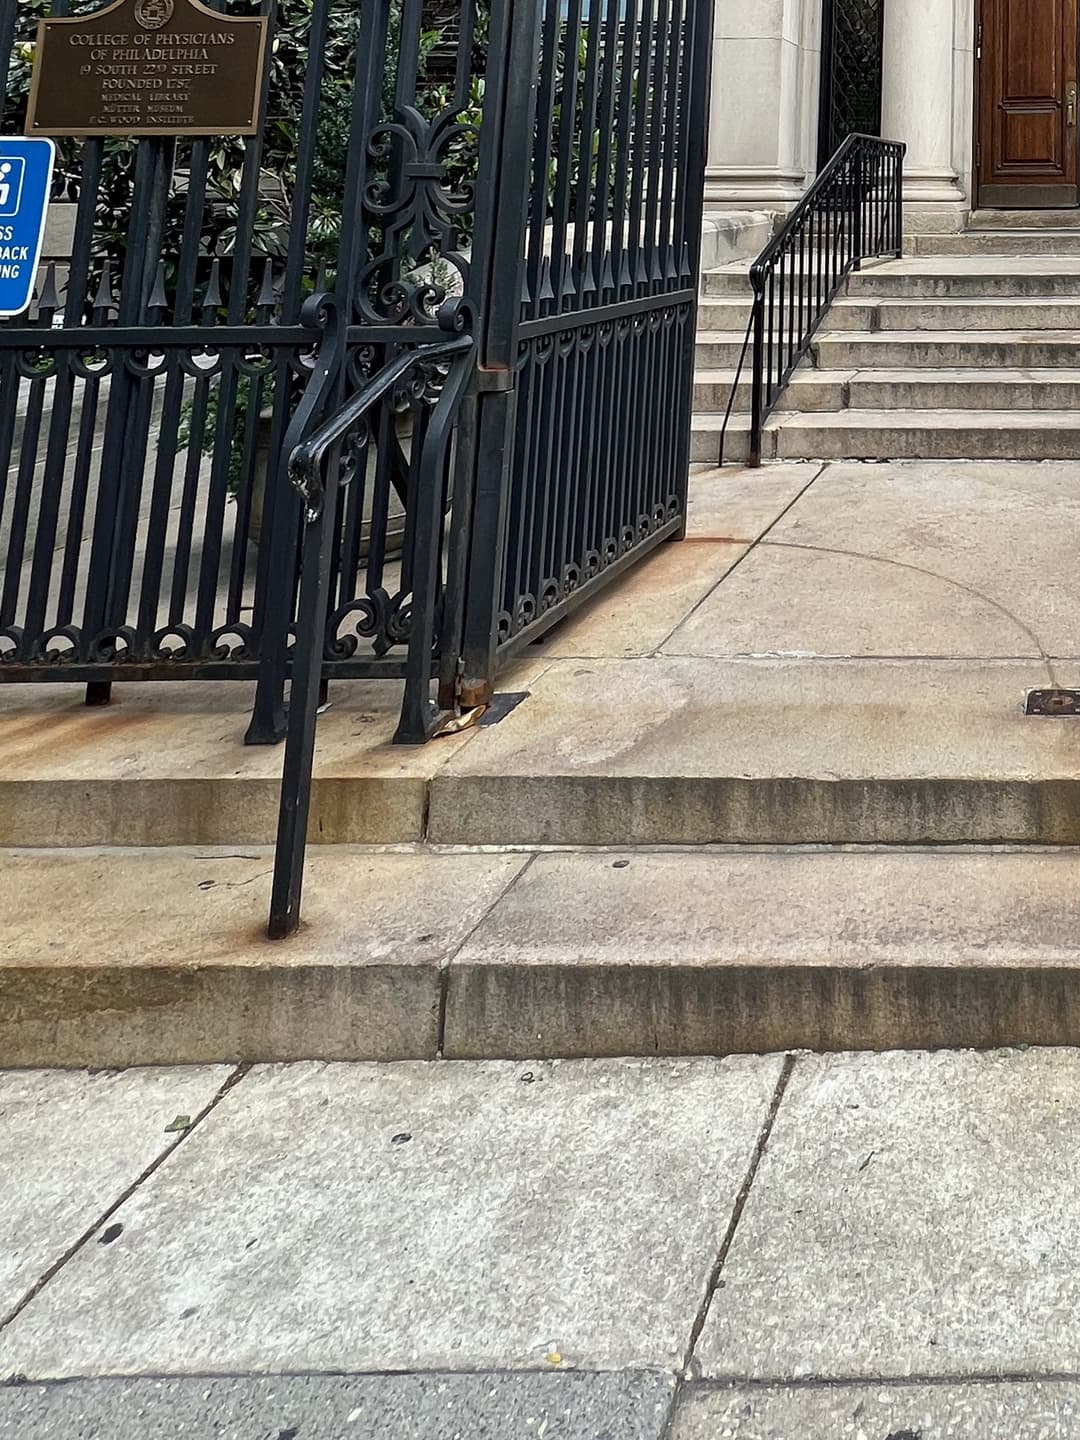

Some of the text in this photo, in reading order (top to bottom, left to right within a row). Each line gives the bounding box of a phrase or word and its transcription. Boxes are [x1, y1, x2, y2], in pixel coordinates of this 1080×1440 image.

[69, 33, 236, 46] COLLEGE OF PHYSICIANS
[90, 48, 209, 61] OF PHILADELPHIA
[80, 64, 91, 75] 19
[95, 64, 137, 75] SOUTH
[171, 64, 219, 75] STREET
[102, 78, 163, 89] FOUNDED
[102, 93, 142, 102] MEDICAL
